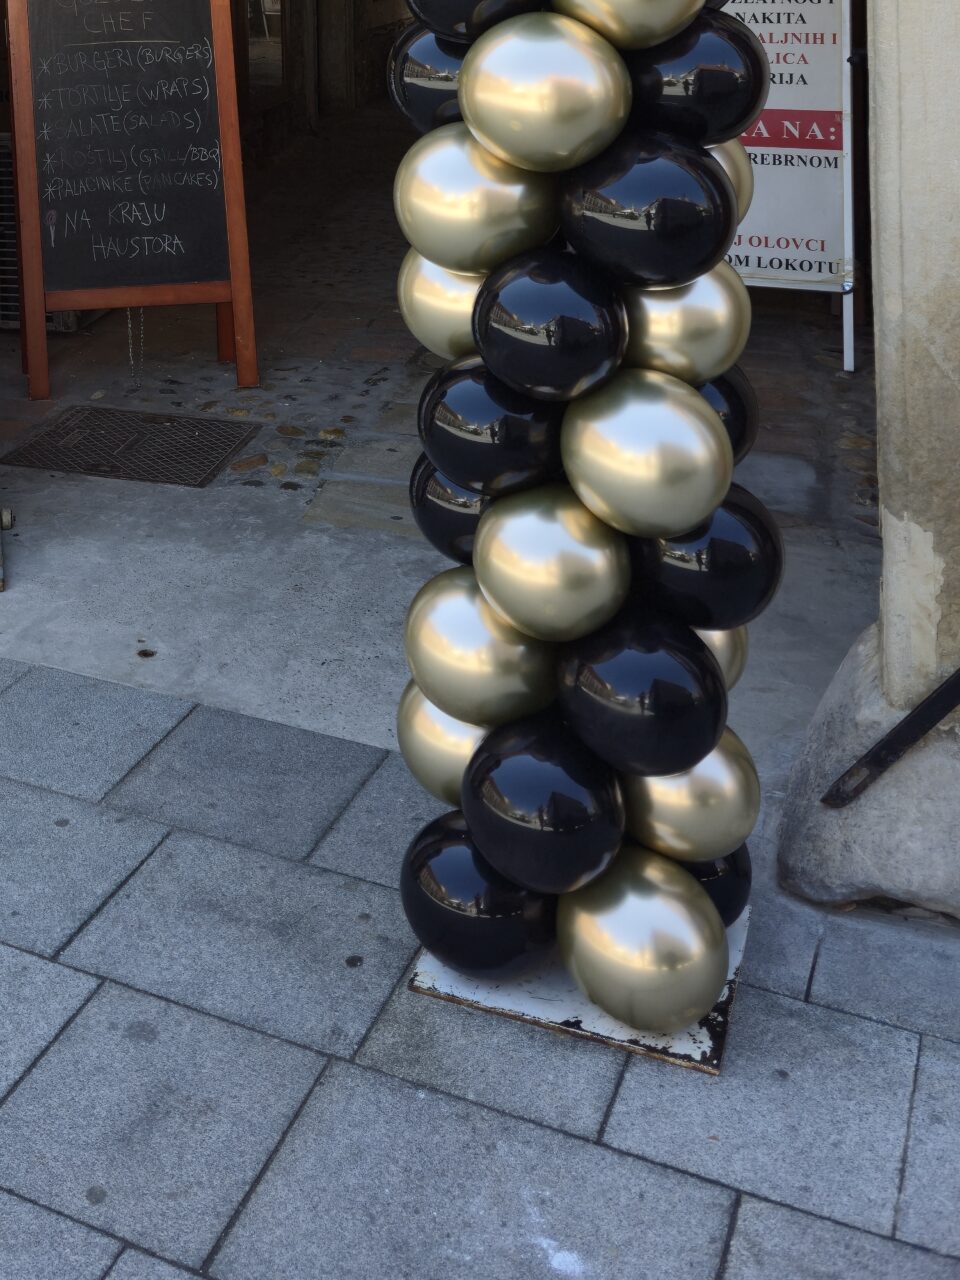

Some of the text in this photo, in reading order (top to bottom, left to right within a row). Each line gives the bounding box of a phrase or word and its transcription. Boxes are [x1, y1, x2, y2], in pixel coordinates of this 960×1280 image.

[84, 11, 154, 33] CHEF
[735, 12, 807, 25] NAKITA
[832, 33, 838, 45] I
[55, 36, 213, 78] BURGERI (BURGERS)
[137, 75, 210, 108] (WRAPS)
[783, 120, 837, 141] NA:
[64, 202, 166, 238] NA KRAJU
[92, 233, 185, 261] HAUSTORA
[748, 235, 826, 252] OLOVCI
[757, 255, 841, 275] LOKOTU
